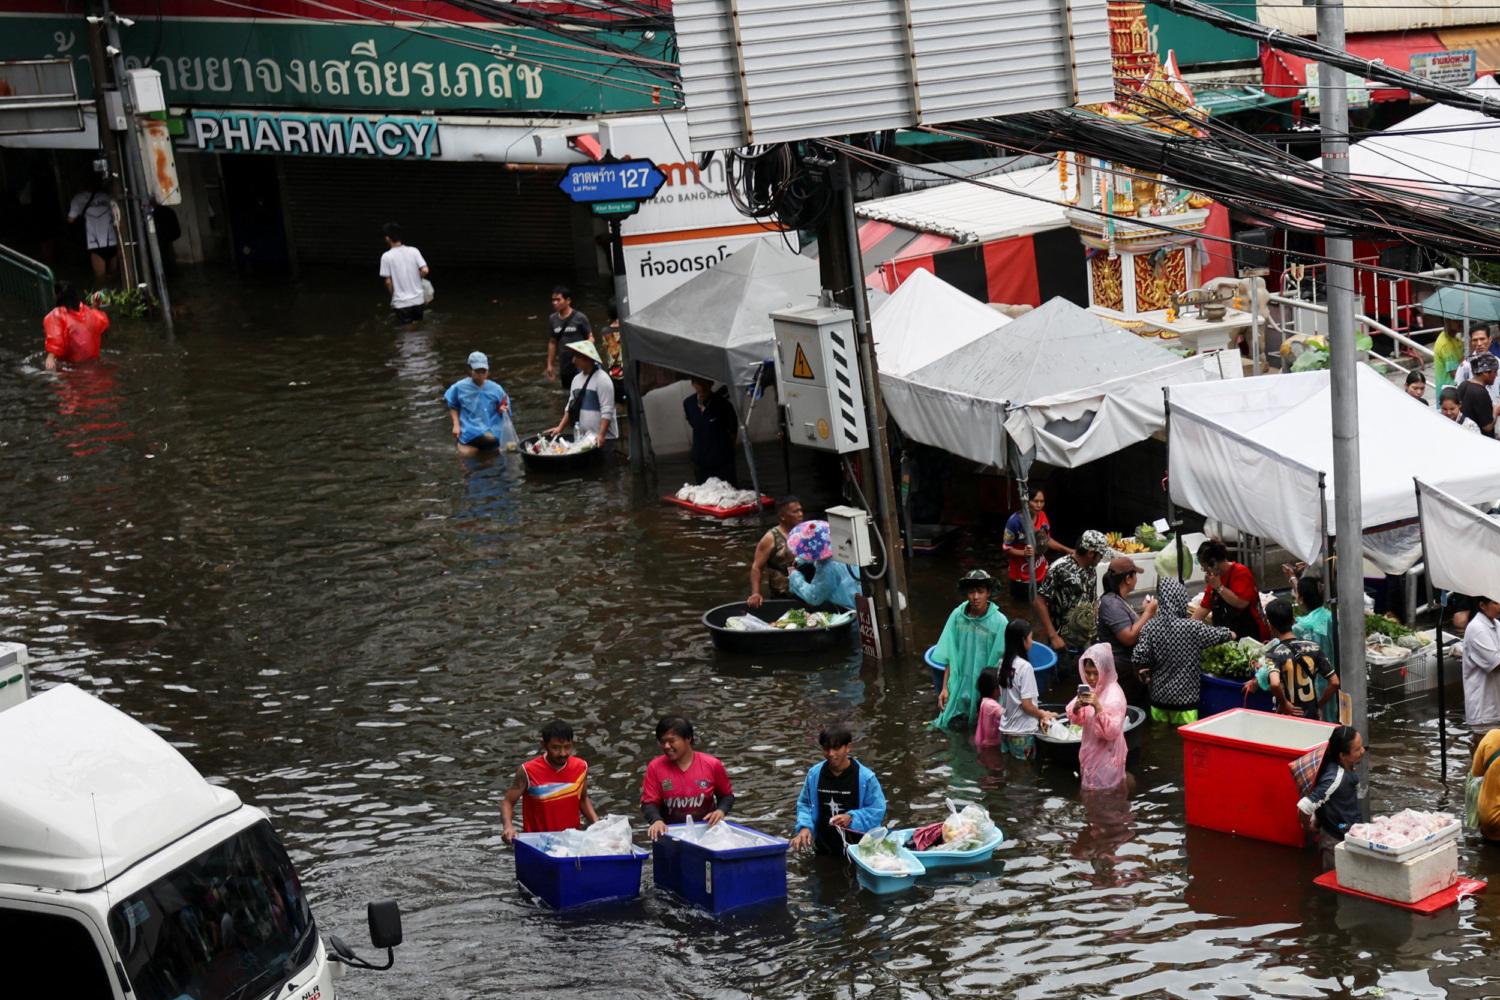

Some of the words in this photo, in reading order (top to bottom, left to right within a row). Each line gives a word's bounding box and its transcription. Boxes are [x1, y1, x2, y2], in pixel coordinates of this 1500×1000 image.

[195, 116, 434, 158] PHARMACY
[572, 167, 616, 184] ลาดพร้าว
[619, 168, 649, 189] 127
[640, 245, 733, 278] ที่จอดรถโ
[1284, 655, 1315, 703] 19
[301, 985, 320, 1000] NLR
